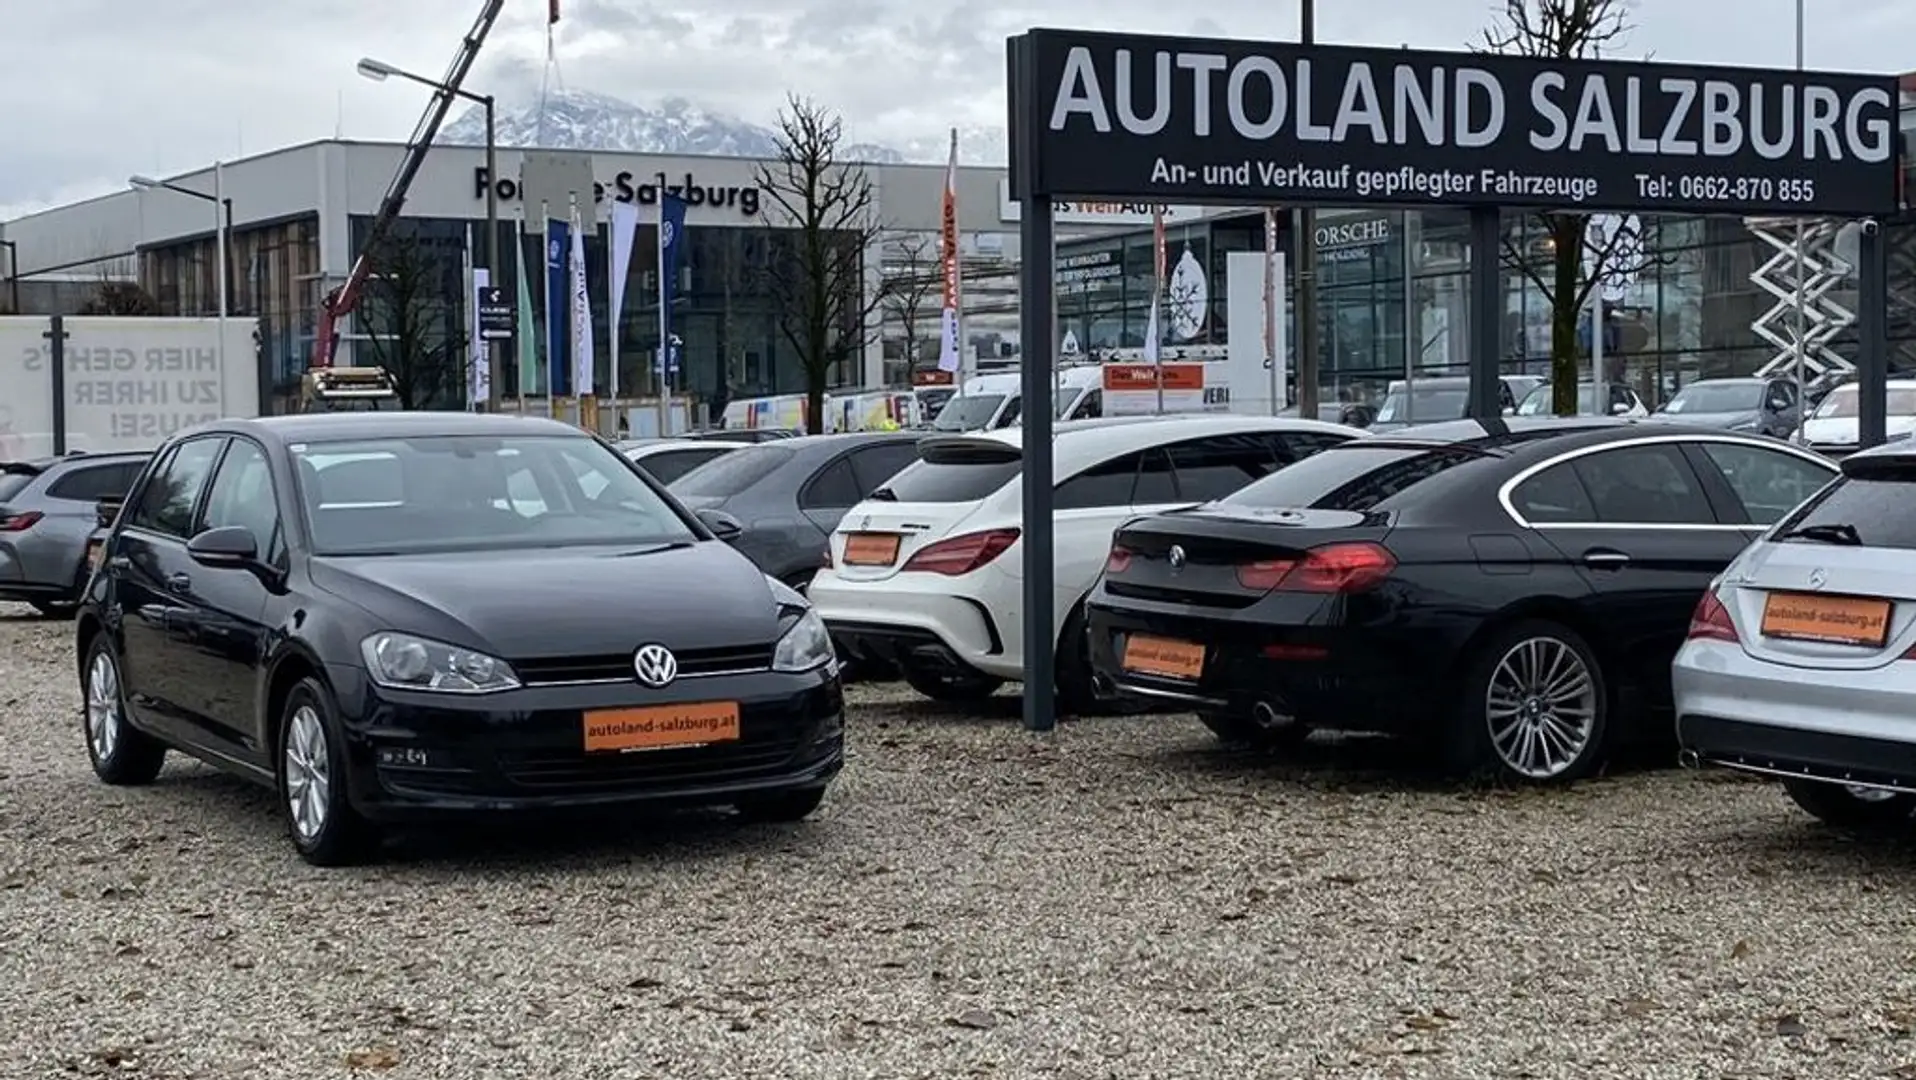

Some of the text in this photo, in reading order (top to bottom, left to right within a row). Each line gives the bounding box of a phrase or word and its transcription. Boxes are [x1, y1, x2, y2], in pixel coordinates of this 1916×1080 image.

[1049, 46, 1890, 163] AUTOLAND SALZBURG
[1151, 157, 1815, 202] An- und Verkauf gepflegter Fahrzeuge Tel: 0662-870 855
[1314, 218, 1389, 247] ORSCHE
[1767, 606, 1884, 629] autoland-salzburg.at
[588, 714, 736, 737] autoland-salzburg.at
